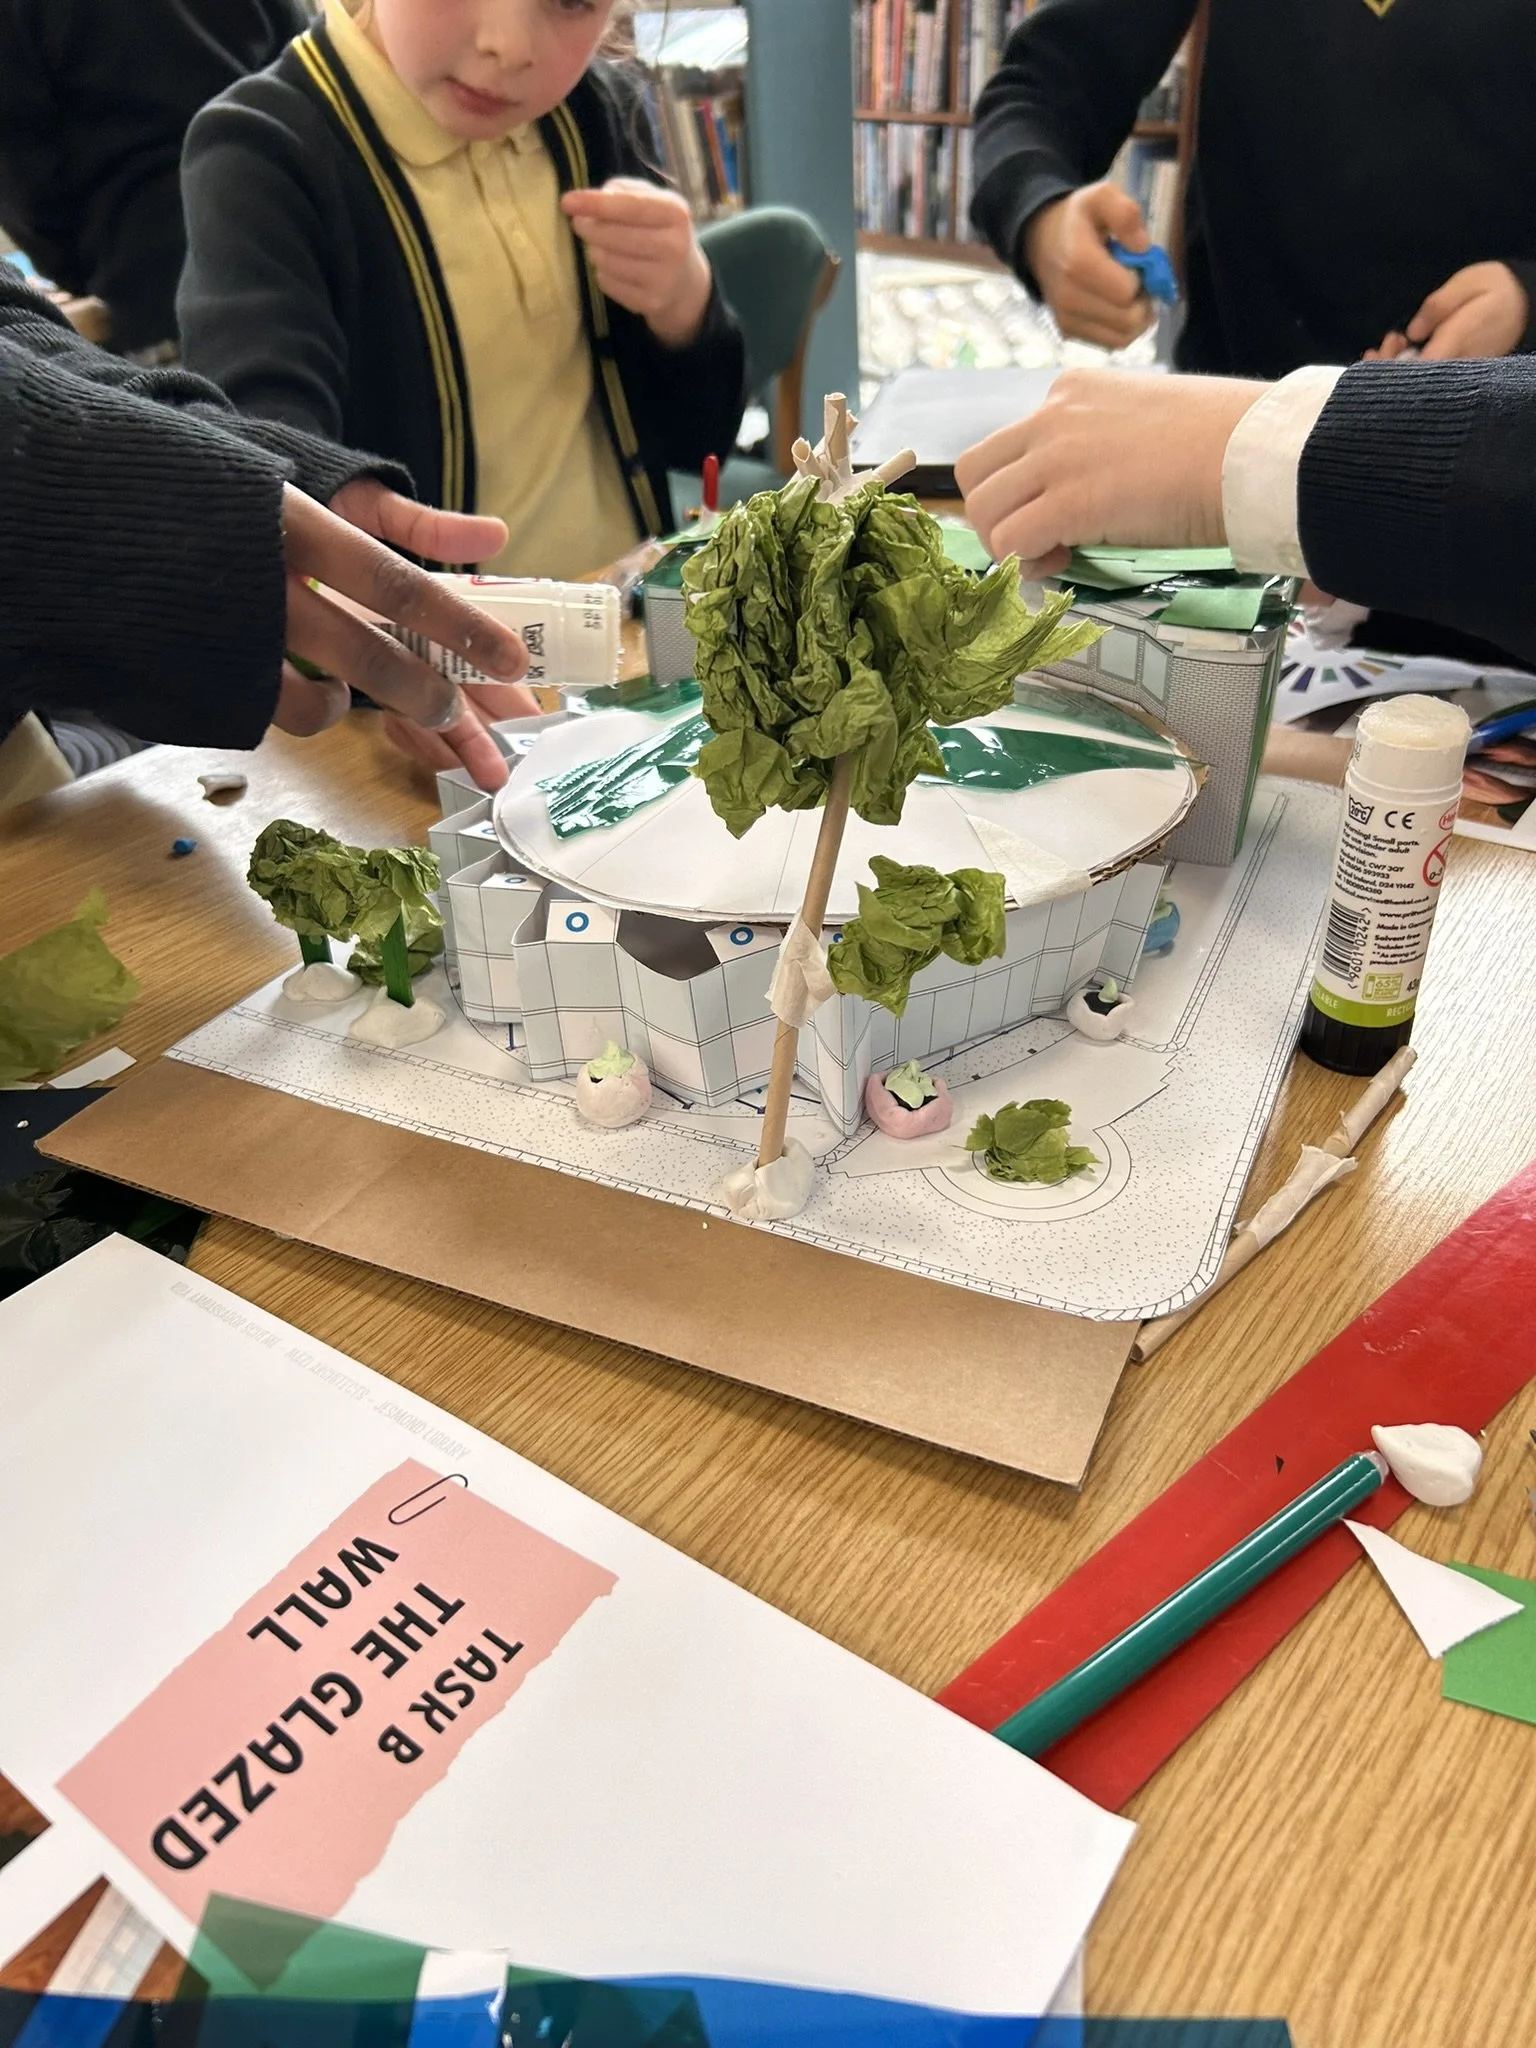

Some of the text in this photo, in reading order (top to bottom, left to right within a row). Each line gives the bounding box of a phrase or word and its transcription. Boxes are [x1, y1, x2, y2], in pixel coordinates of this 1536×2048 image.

[1350, 805, 1367, 821] 20°C
[1384, 811, 1416, 829] CE
[1344, 821, 1371, 840] Warning!
[1372, 835, 1396, 847] Small
[1351, 836, 1362, 845] use
[1363, 840, 1387, 851] under
[1388, 846, 1410, 854] adult
[1368, 862, 1386, 872] CW7
[1378, 881, 1394, 889] D24
[373, 1399, 427, 1434] JESMOND
[422, 1419, 471, 1462] LIBRARY
[247, 1537, 400, 1652] WALL
[377, 1629, 524, 1764] TASK B
[149, 1582, 466, 1871] THE GLAZED
